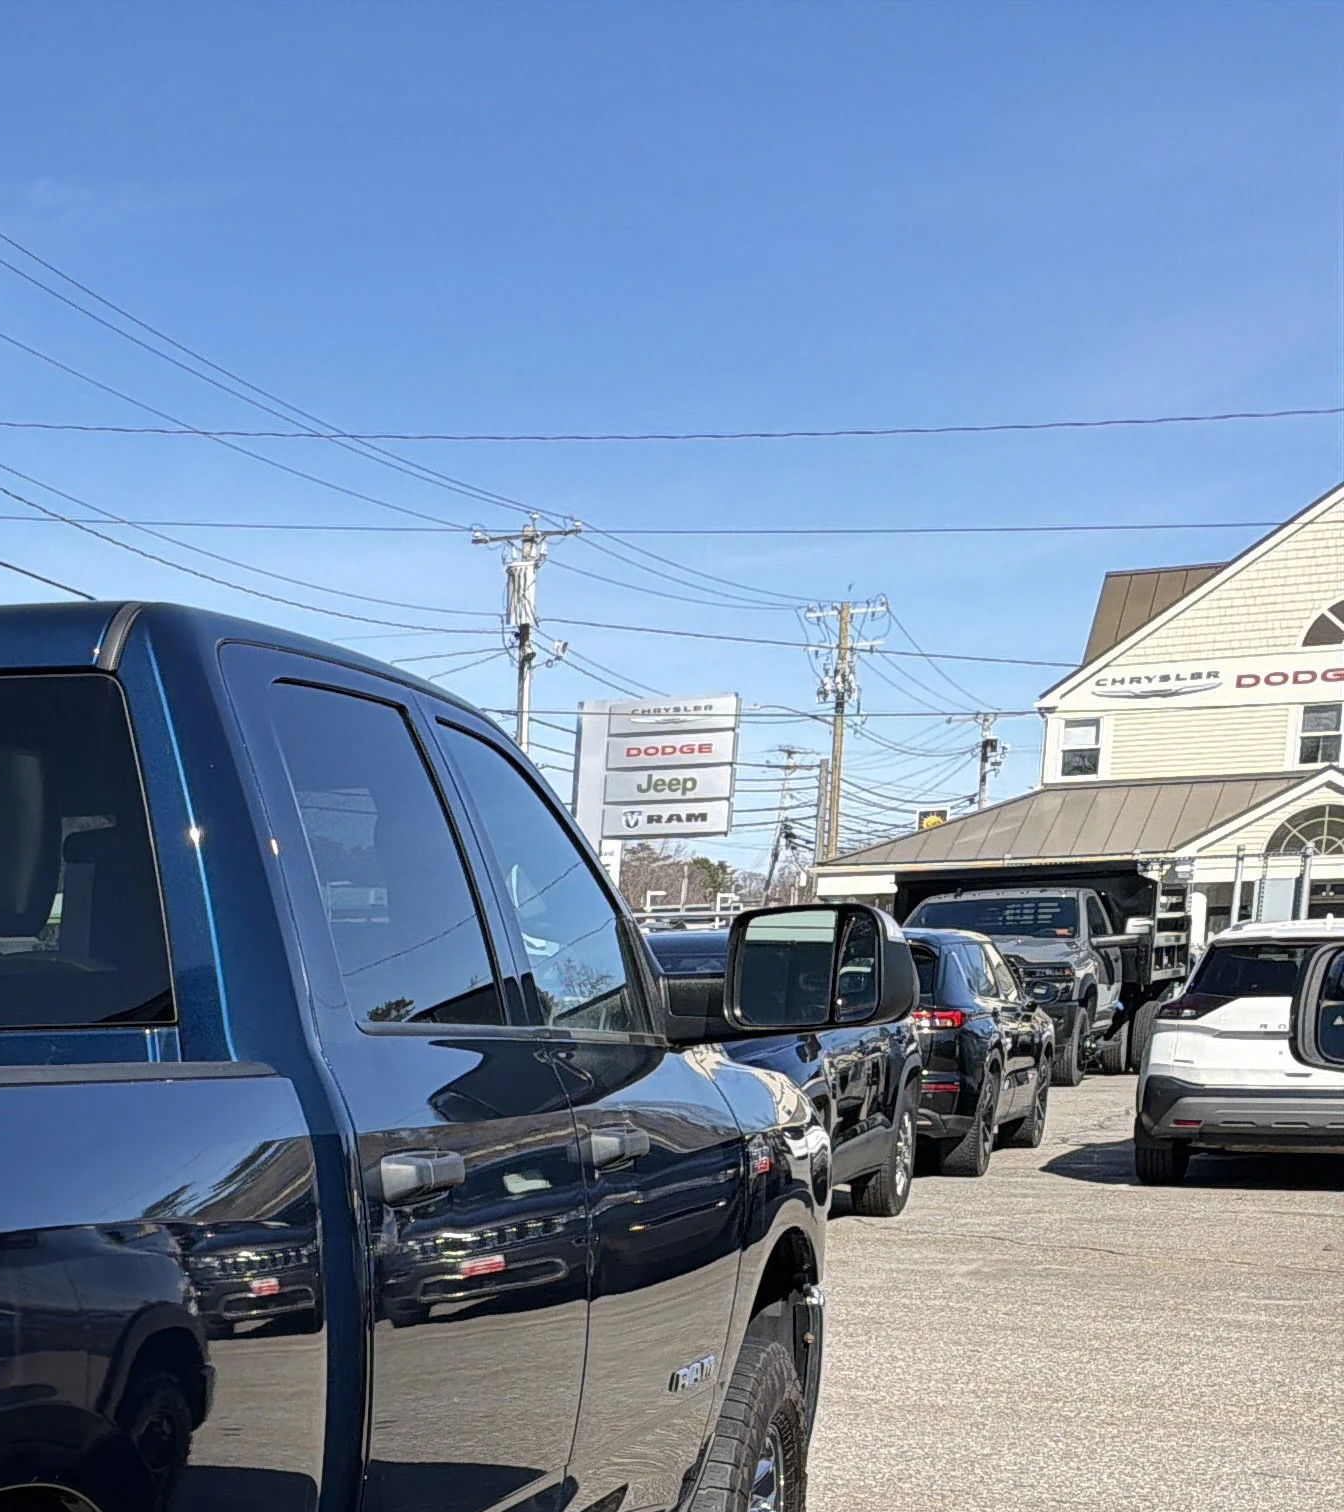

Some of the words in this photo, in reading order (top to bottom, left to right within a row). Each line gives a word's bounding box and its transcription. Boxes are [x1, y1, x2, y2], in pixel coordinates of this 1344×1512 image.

[1094, 670, 1221, 687] CHRYSLER
[630, 705, 713, 715] CHRYSLER
[626, 743, 714, 758] DODGE
[636, 774, 698, 796] Jeep
[646, 812, 708, 824] RAM
[669, 1354, 716, 1393] RAM
